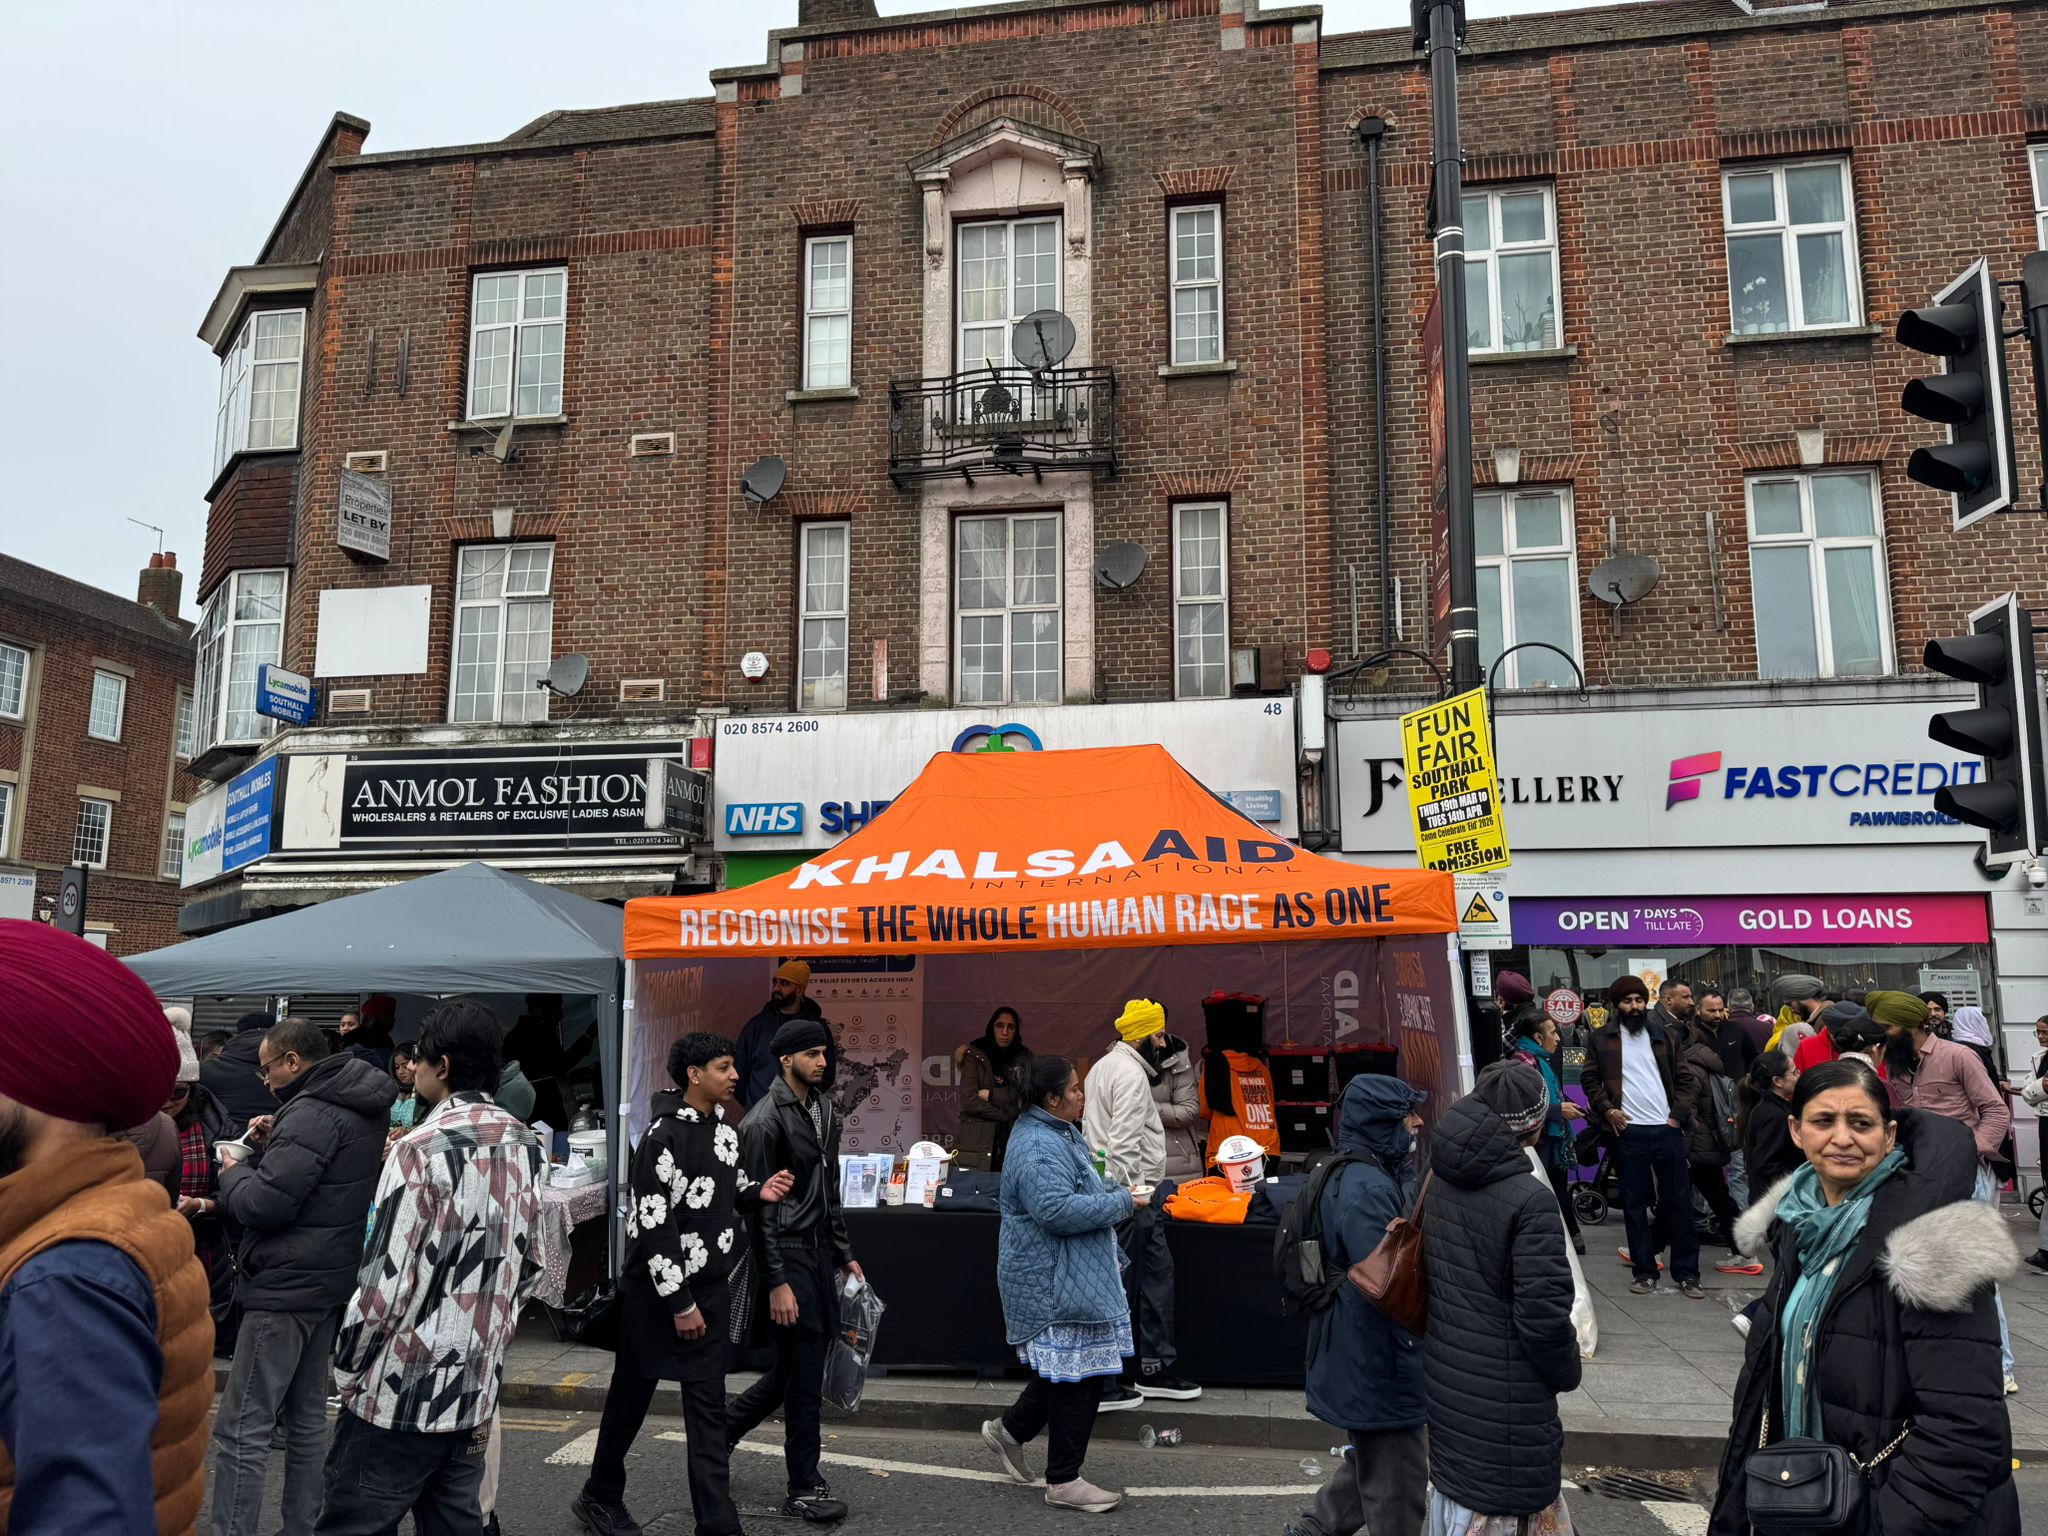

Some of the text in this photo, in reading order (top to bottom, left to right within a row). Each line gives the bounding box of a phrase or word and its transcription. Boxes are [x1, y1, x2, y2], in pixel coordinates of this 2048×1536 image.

[345, 494, 388, 516] Properties
[344, 510, 386, 531] LET BY
[268, 675, 307, 696] Lycamobile
[269, 694, 304, 712] SOUTHALL
[271, 704, 302, 720] MOBILES
[1263, 702, 1282, 715] 48
[724, 720, 819, 735] 020 8574 2600
[1417, 701, 1471, 743] FUN
[1417, 730, 1479, 772] FAIR
[1412, 756, 1485, 789] SOUTHALL
[227, 770, 272, 807] SOUTHALL MOBILES
[351, 773, 648, 808] ANMOL FASHION
[667, 776, 705, 805] ANMOL
[1430, 776, 1471, 800] PARK
[1245, 794, 1274, 803] Healthy
[1245, 802, 1269, 810] Living
[1418, 791, 1488, 818] THUR 19th MAR to
[352, 807, 645, 823] WHOLESALERS & RETAILERS OF EXCLUSIVE LADIES ASIAN
[729, 804, 798, 832] NHS
[1426, 804, 1483, 828] TUES 14th APR
[1420, 831, 1440, 842] Come
[1437, 823, 1467, 839] Celebrate
[1478, 816, 1494, 829] 2026
[633, 837, 644, 845] 020
[644, 836, 662, 845] 8574
[662, 835, 678, 845] 3403
[1446, 838, 1480, 857] FREE
[787, 829, 1295, 889] KHALSA AID
[1428, 846, 1504, 872] ADMISSION
[969, 862, 1302, 890] INTERNATIONAL
[65, 892, 76, 907] 20
[680, 883, 1395, 947] RECOGNISE THE WHOLE HUMAN RACE AS ONE
[1558, 911, 1629, 931] OPEN
[1633, 908, 1678, 919] 7 DAYS
[1738, 908, 1913, 930] GOLD LOANS
[1644, 920, 1692, 931] TILL LATE
[1474, 984, 1489, 992] 1794
[1476, 976, 1487, 984] EC
[1547, 1000, 1581, 1011] SALE
[1241, 1085, 1268, 1095] HUMAN
[1260, 1095, 1270, 1105] AS
[1246, 1104, 1274, 1123] ONE
